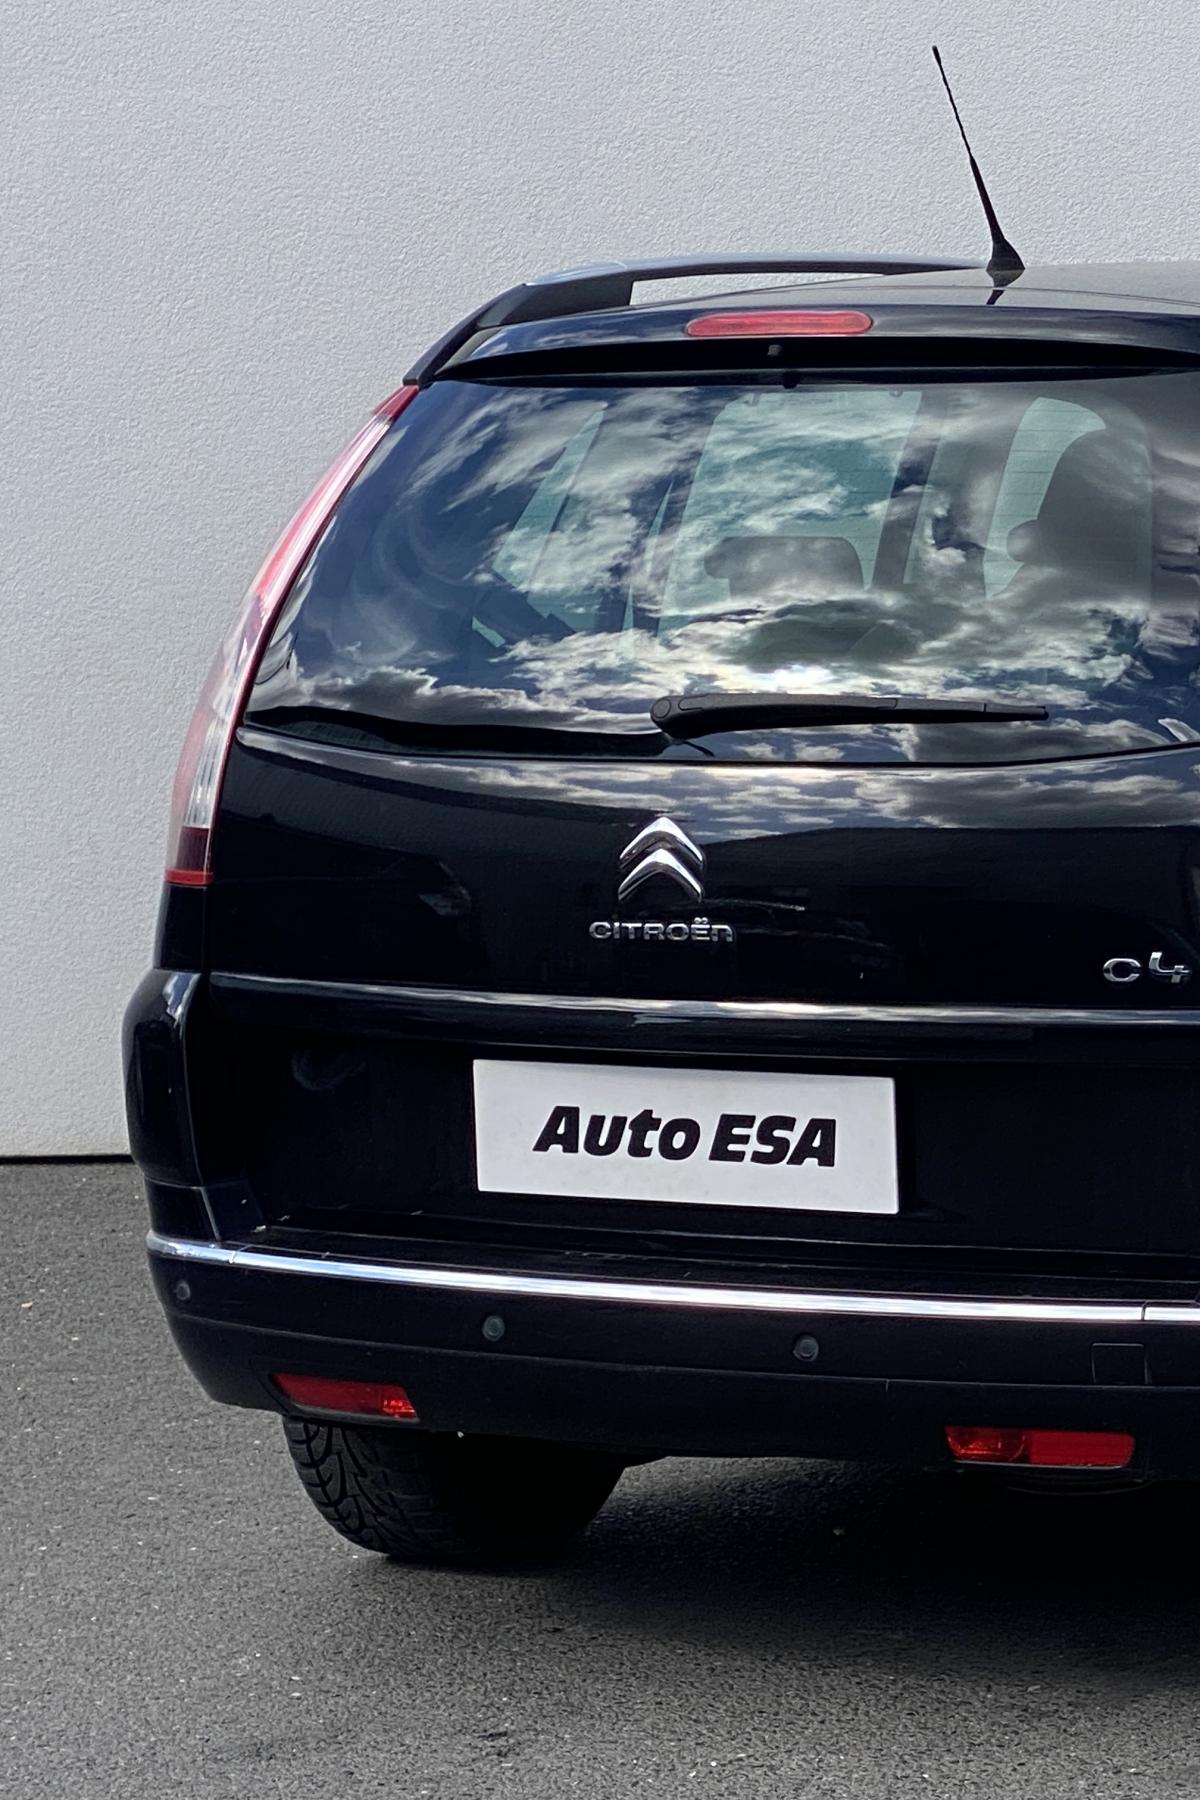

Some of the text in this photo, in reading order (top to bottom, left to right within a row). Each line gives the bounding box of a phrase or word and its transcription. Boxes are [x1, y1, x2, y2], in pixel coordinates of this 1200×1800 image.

[1102, 951, 1191, 984] C4
[532, 1105, 837, 1168] Auto ESA
